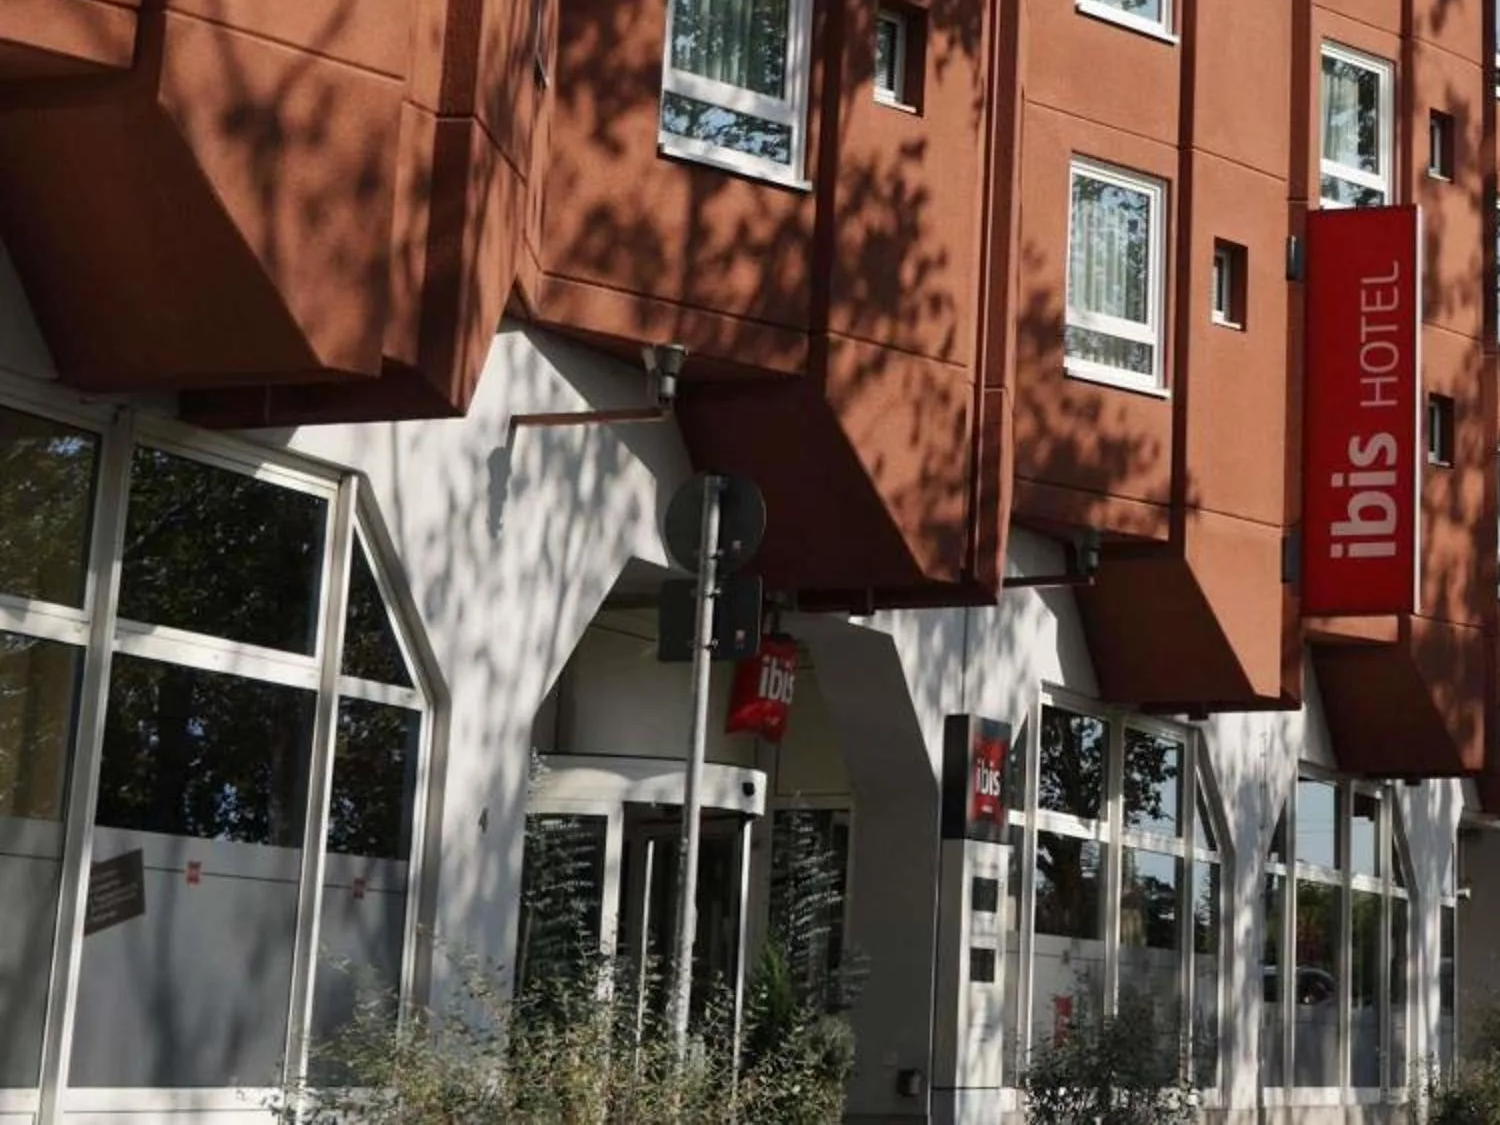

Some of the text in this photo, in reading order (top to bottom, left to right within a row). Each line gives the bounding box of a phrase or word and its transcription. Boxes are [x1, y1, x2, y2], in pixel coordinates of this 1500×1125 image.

[1330, 260, 1399, 558] ibis HOTEL
[975, 758, 1001, 796] ibis
